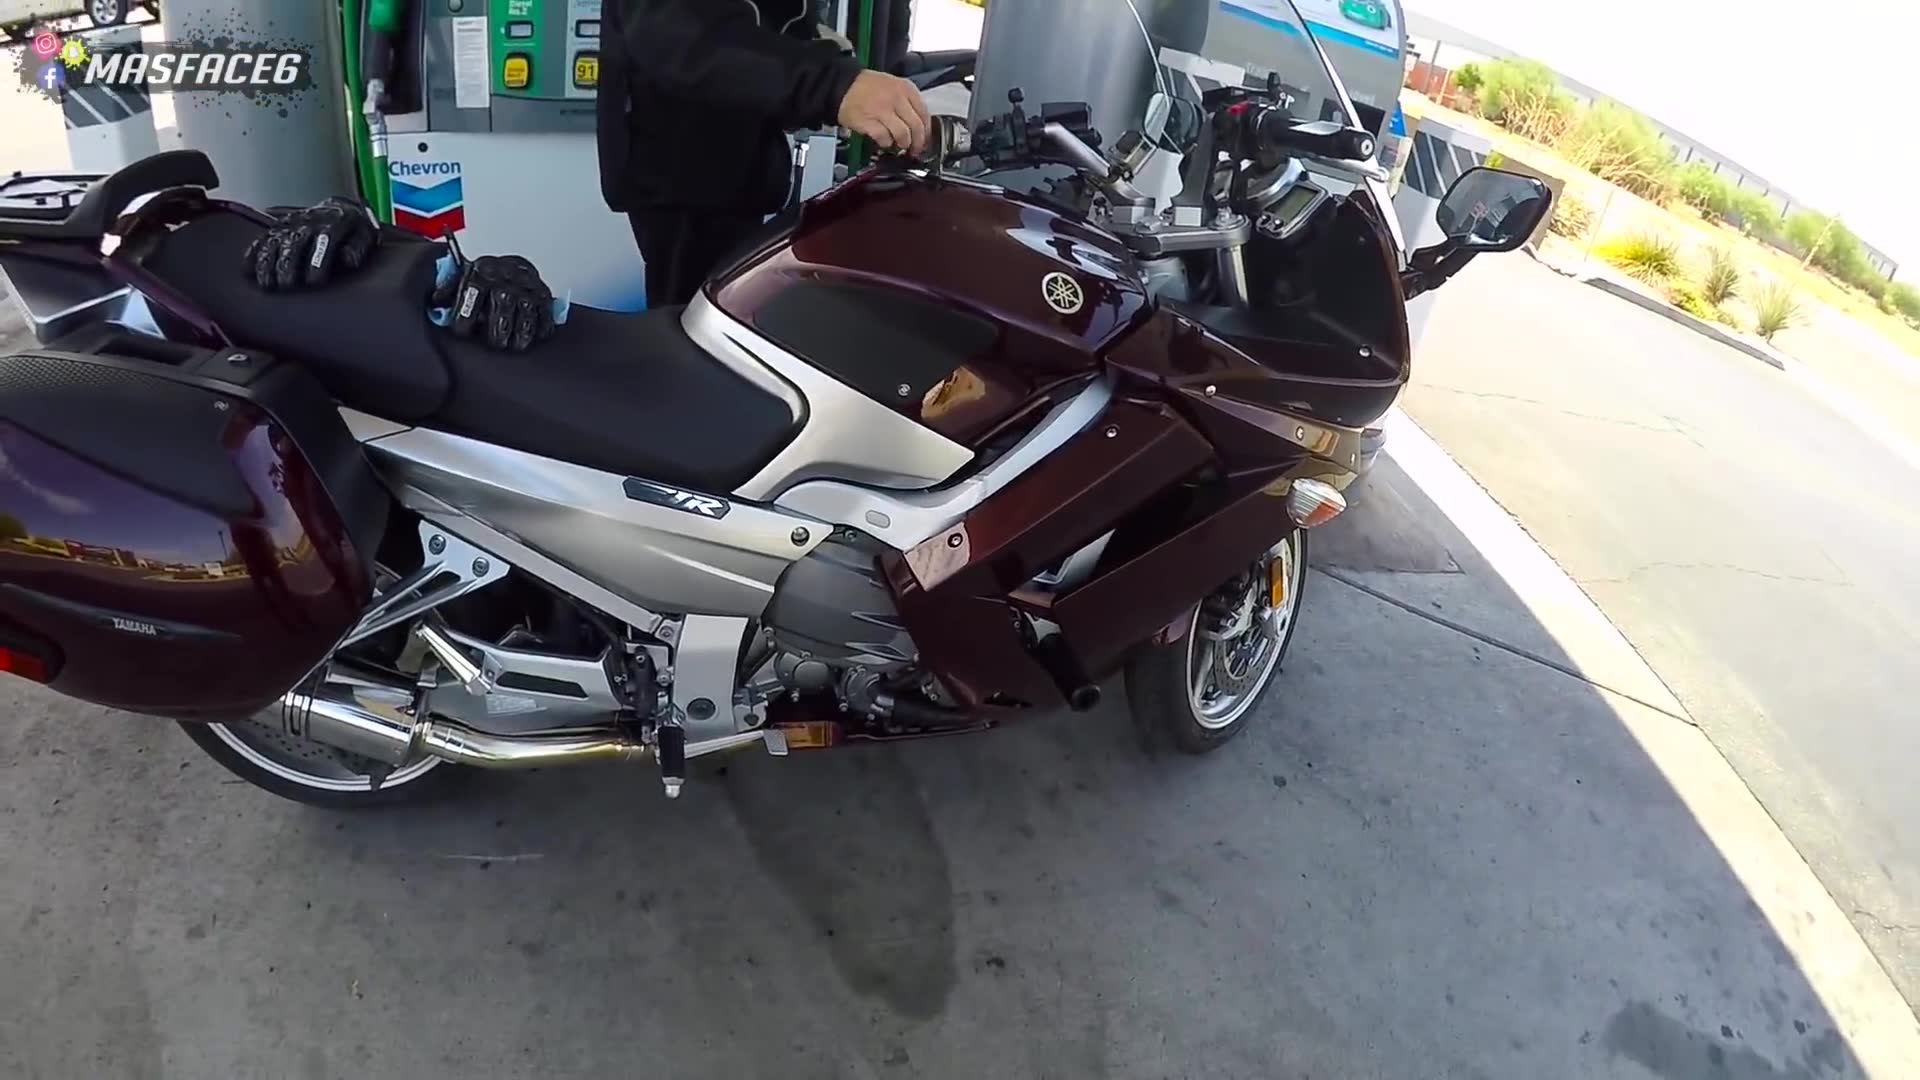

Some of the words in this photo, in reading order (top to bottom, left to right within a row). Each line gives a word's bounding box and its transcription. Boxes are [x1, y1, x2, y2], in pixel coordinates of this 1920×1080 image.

[577, 64, 594, 78] 91
[388, 161, 461, 176] Chevron
[112, 617, 157, 636] YAMAHA
